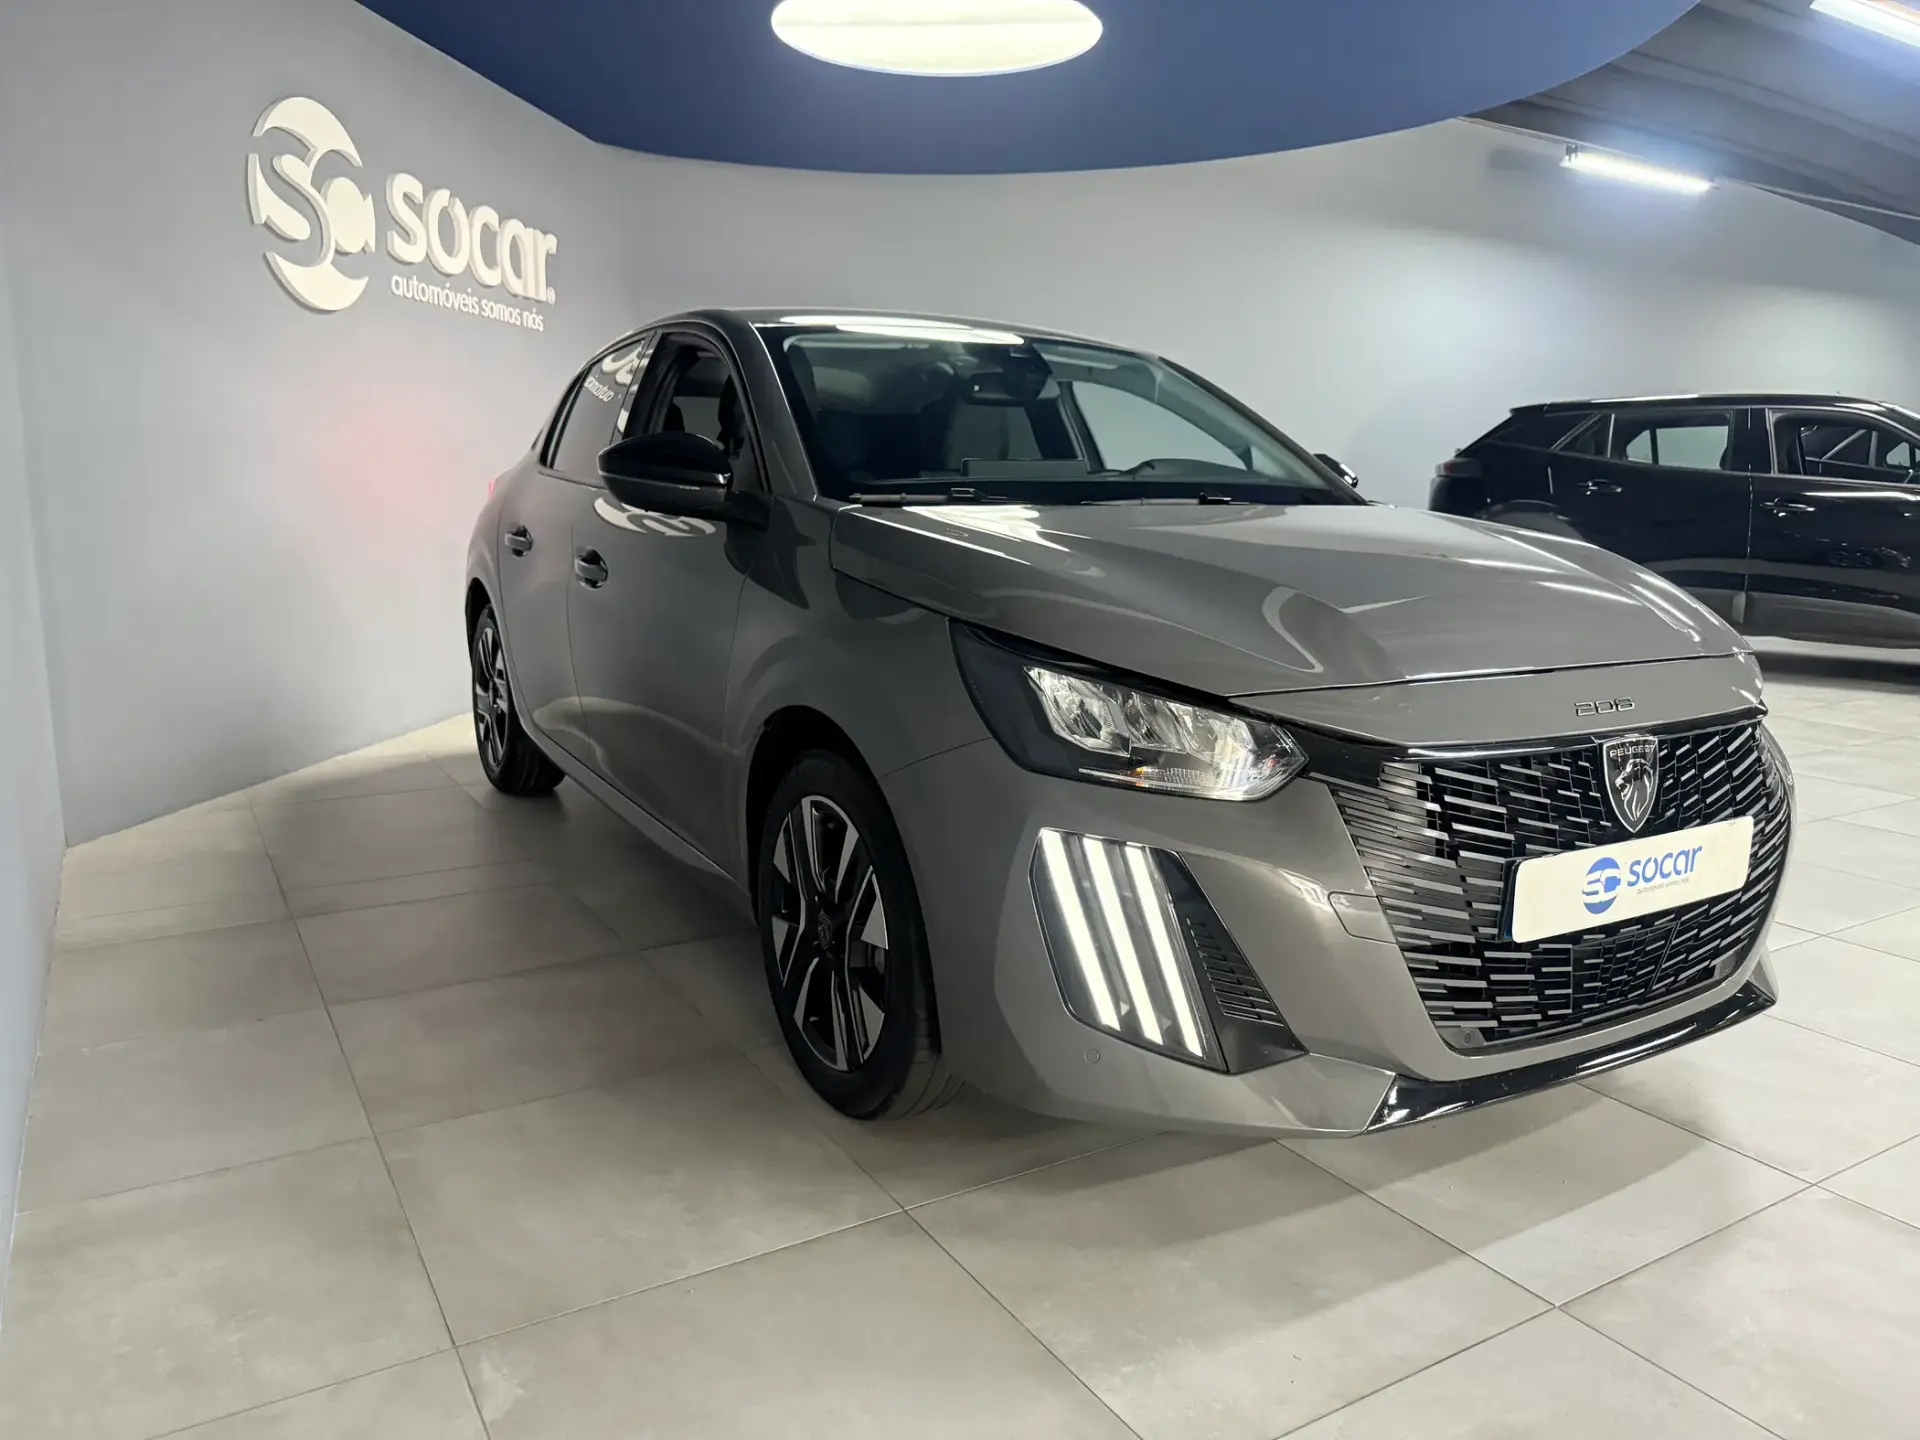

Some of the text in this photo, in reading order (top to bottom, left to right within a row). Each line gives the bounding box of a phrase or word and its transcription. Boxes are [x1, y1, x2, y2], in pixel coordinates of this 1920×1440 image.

[390, 273, 545, 333] automóveis somos nós
[1574, 696, 1636, 717] 208
[1609, 744, 1655, 758] PEUGEOT
